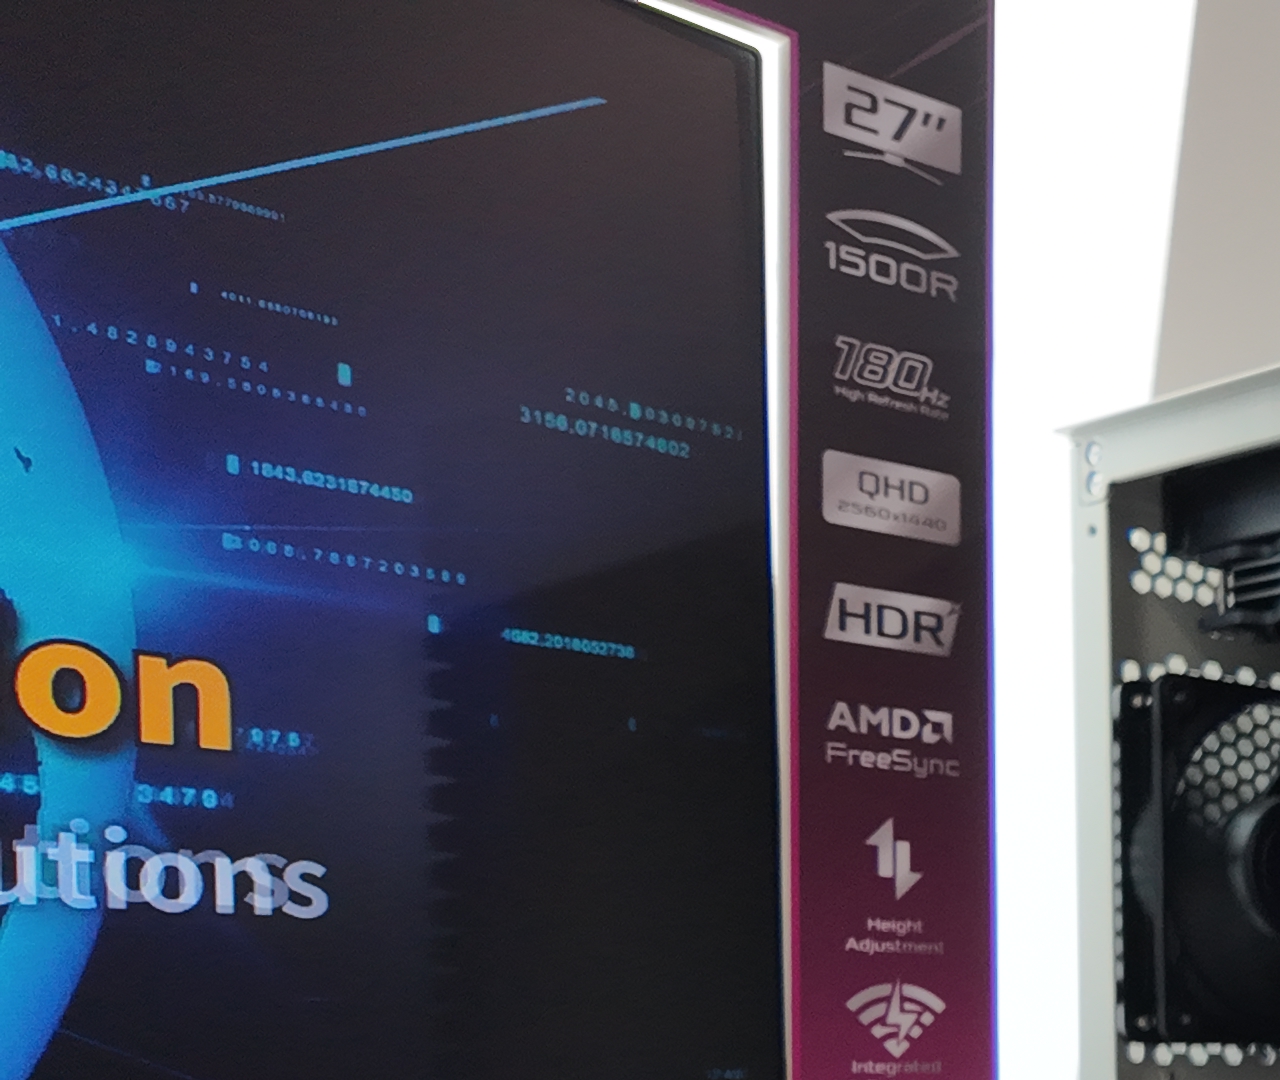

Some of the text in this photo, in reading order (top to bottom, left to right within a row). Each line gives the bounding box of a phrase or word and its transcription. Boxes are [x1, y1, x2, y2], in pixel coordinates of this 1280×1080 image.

[823, 240, 959, 303] 1500R
[857, 470, 930, 506] QHD
[838, 597, 945, 647] HDR
[826, 700, 921, 740] AMD
[824, 741, 961, 779] FreeSync
[866, 918, 923, 937] Height
[845, 937, 945, 956] Adjustment
[851, 1060, 942, 1078] Integrated
